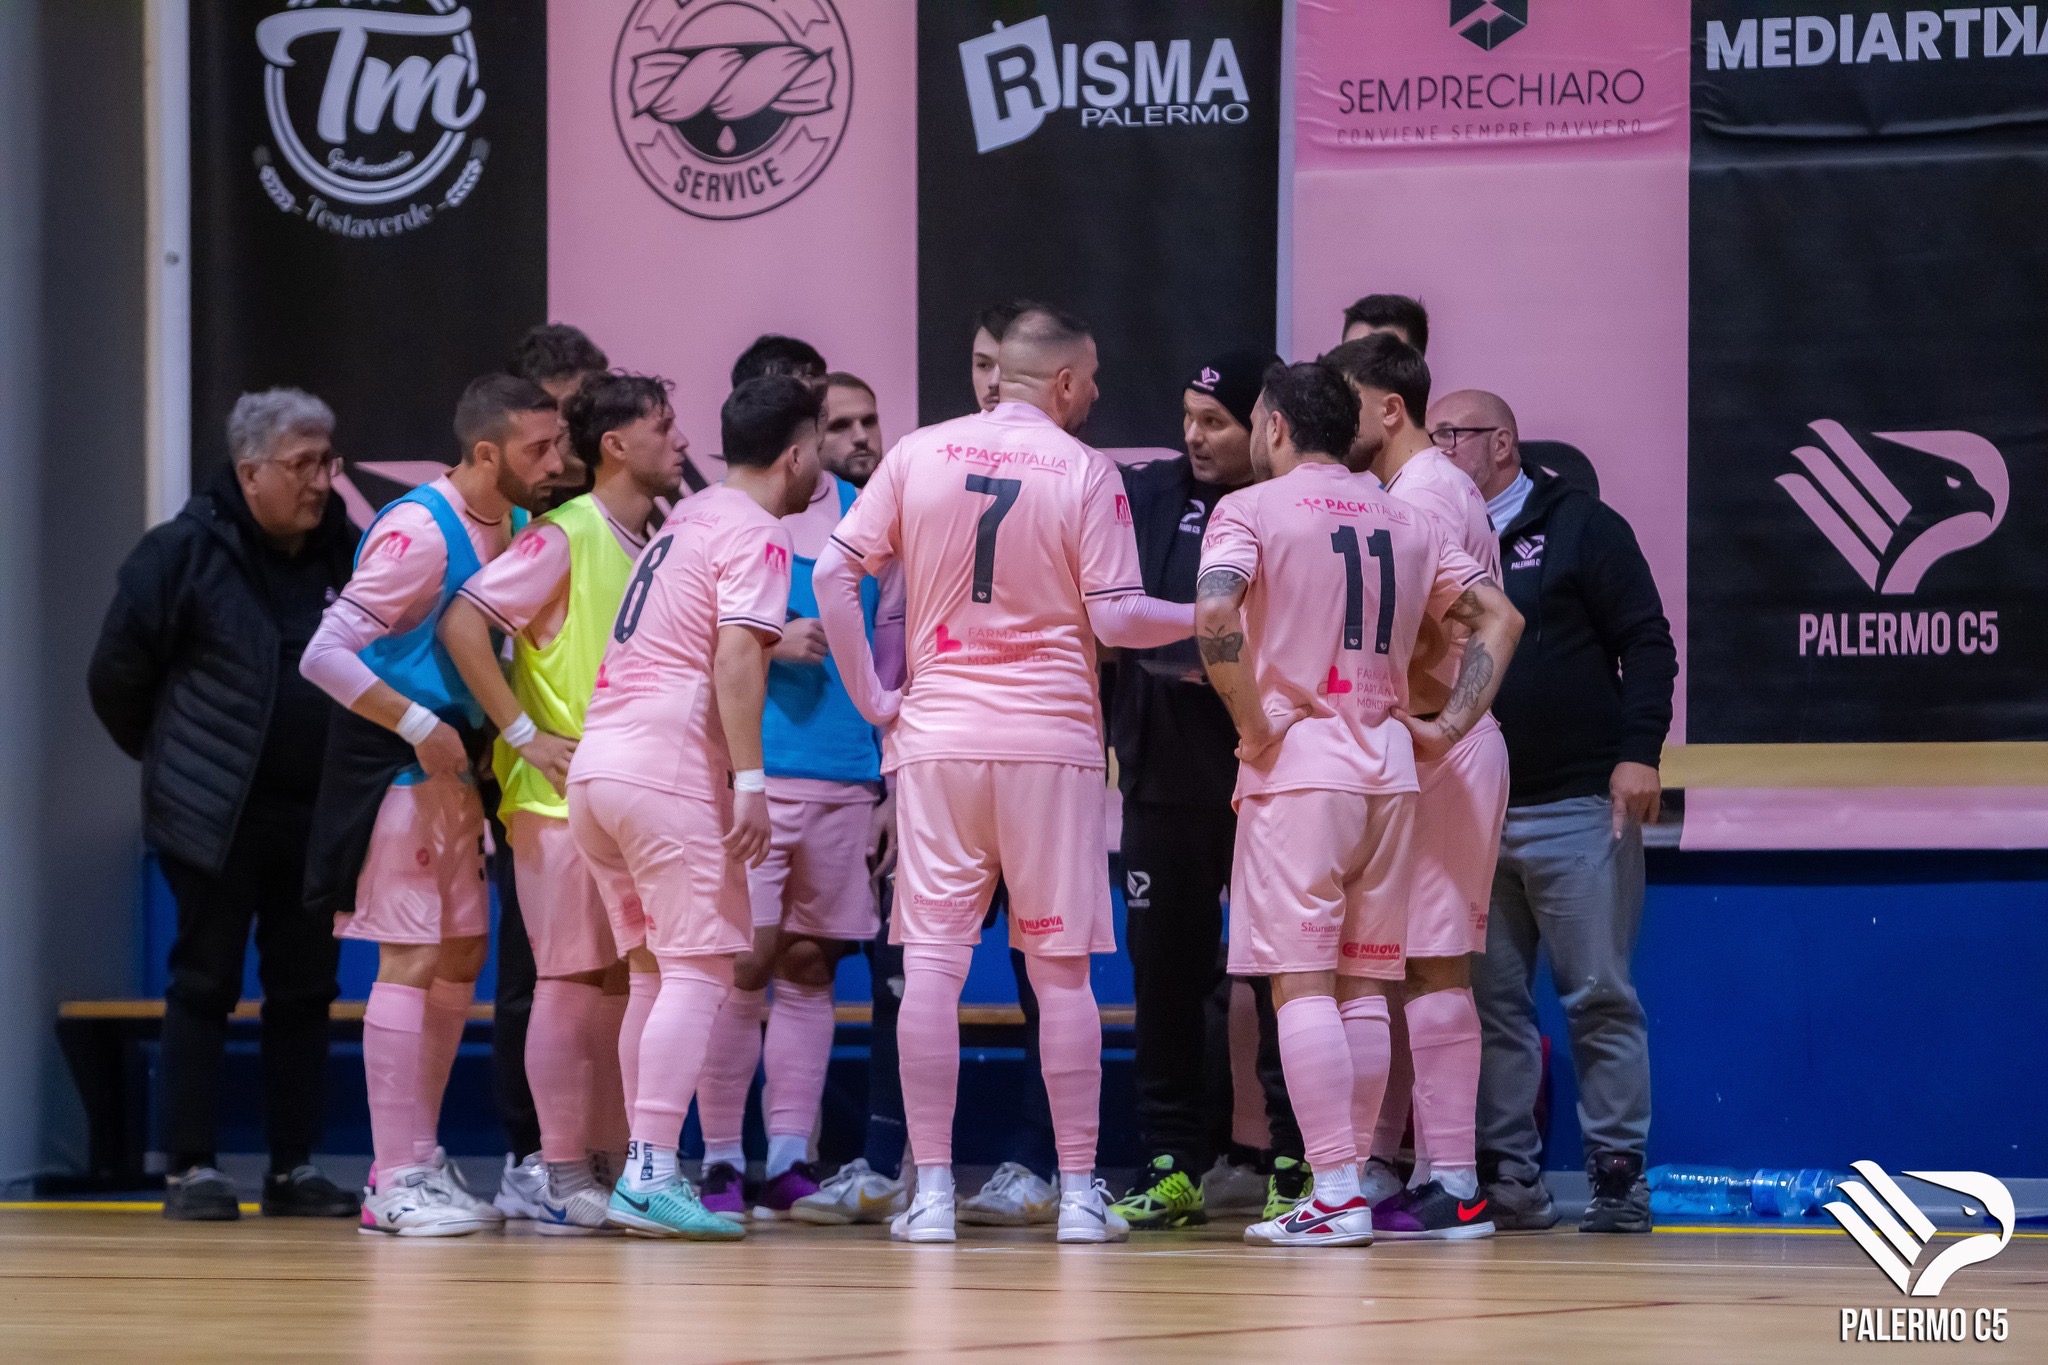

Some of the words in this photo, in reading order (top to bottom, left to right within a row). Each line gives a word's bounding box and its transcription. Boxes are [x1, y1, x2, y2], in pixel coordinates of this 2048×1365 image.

[1338, 68, 1645, 115] SEMPRECHIARO
[1081, 103, 1249, 128] PALERMO
[1336, 125, 1438, 144] CONVIENE
[674, 157, 785, 202] SERVICE
[964, 446, 1068, 471] PACKITALIA
[965, 473, 1022, 604] 7
[614, 534, 674, 644] 8
[1330, 525, 1396, 655] 11
[1799, 612, 1951, 656] PALERMO
[1958, 610, 1999, 655] C5
[1025, 916, 1063, 929] NUOVA
[1361, 944, 1400, 954] NUOVA
